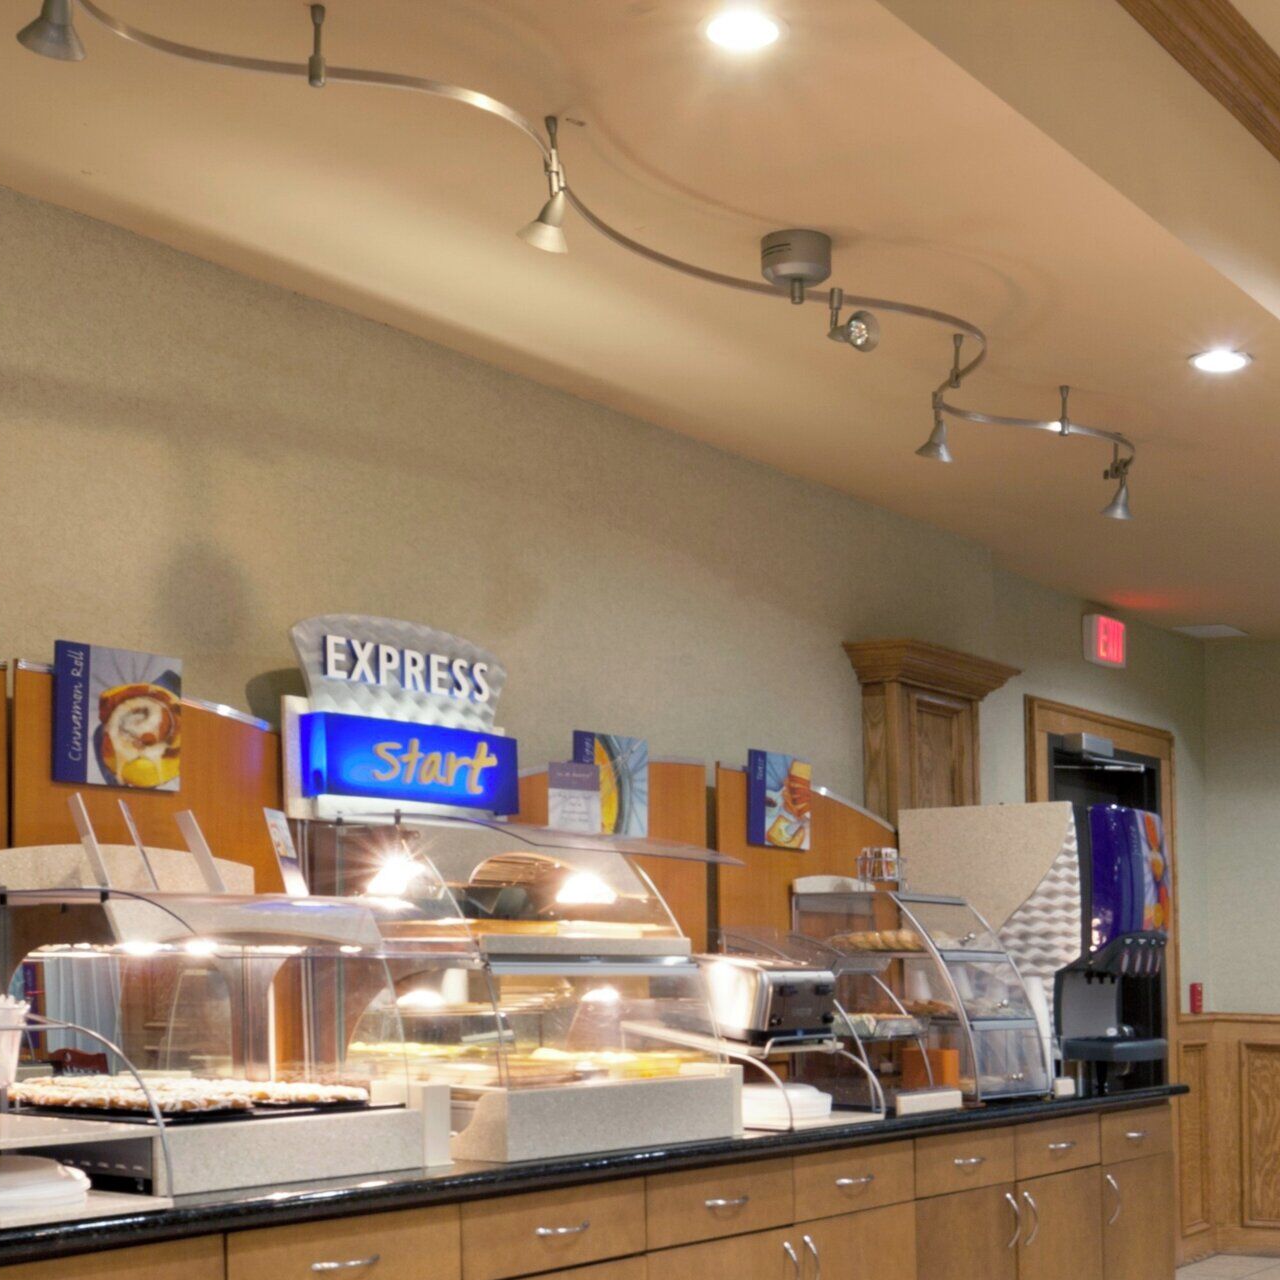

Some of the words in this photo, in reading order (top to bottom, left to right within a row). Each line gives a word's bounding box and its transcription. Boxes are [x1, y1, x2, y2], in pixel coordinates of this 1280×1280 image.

[66, 650, 85, 677] Roll
[1099, 618, 1124, 662] EXIT
[323, 634, 490, 703] EXPRESS
[67, 683, 85, 762] Cinnamon
[373, 738, 497, 794] Start
